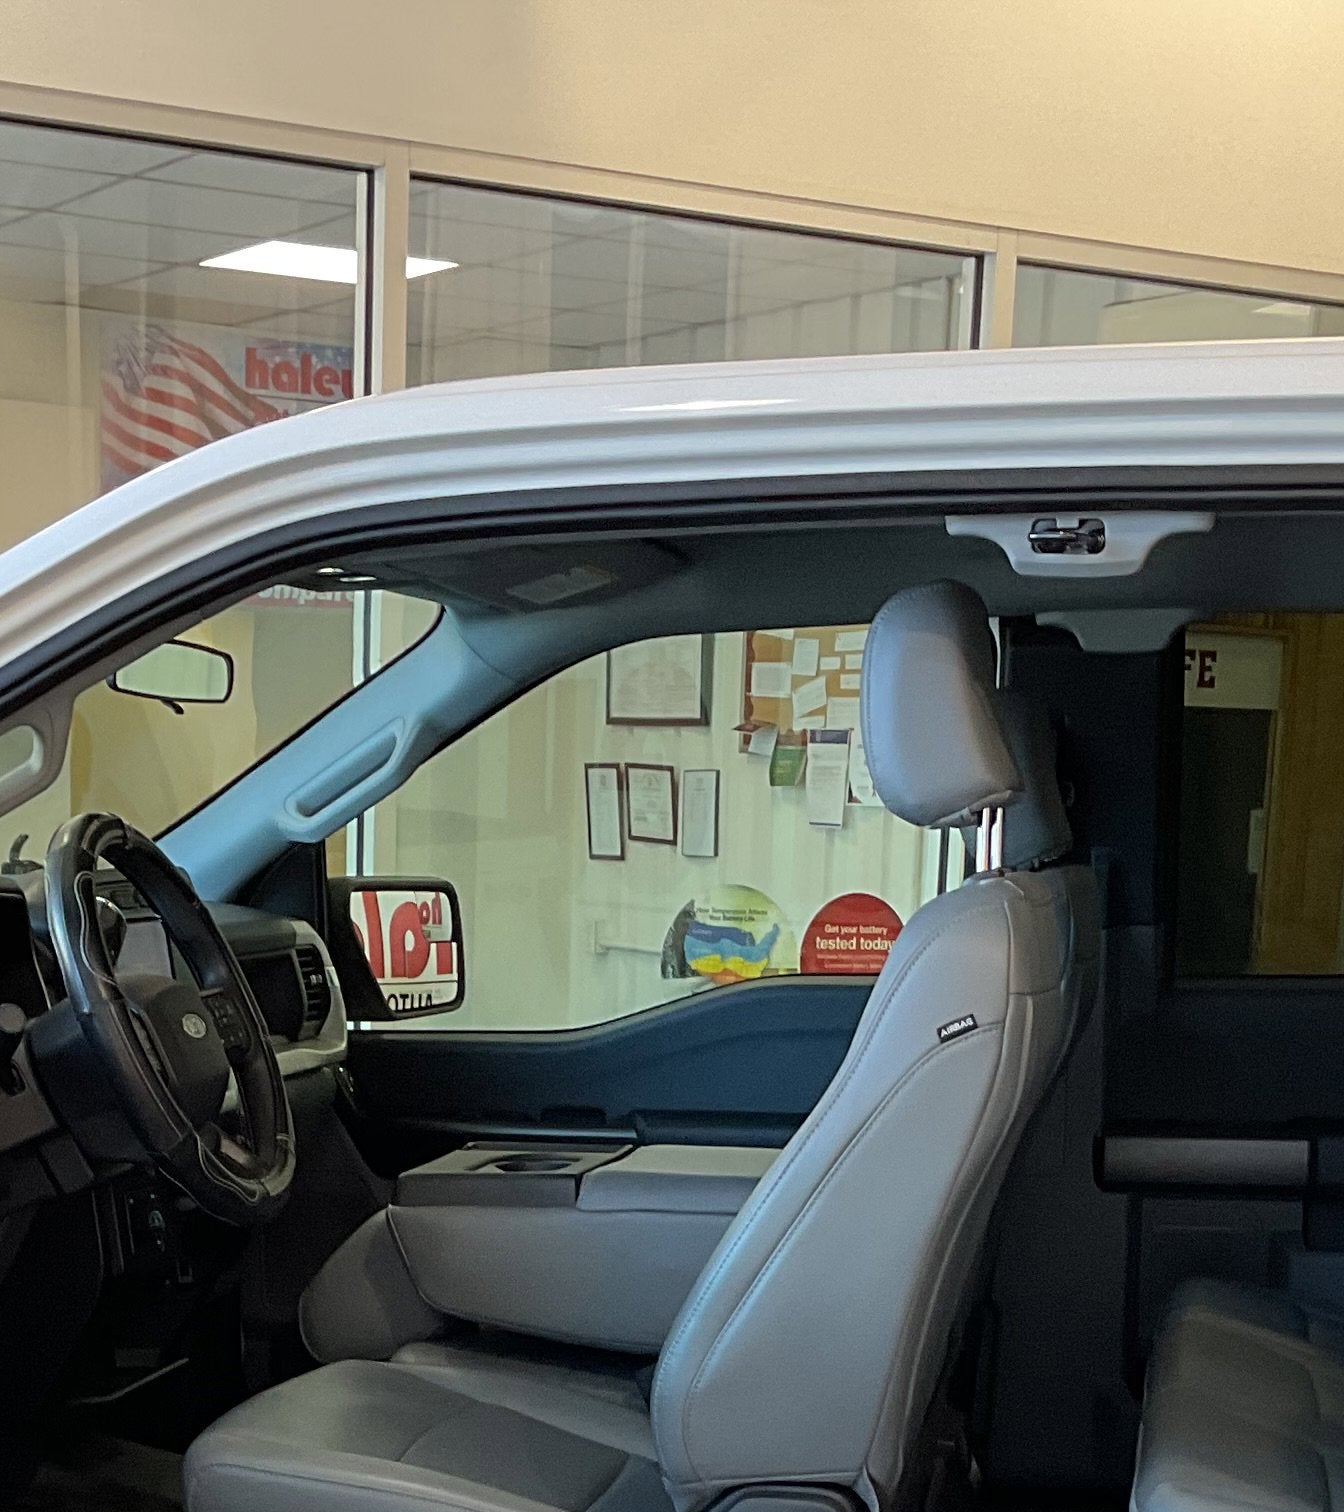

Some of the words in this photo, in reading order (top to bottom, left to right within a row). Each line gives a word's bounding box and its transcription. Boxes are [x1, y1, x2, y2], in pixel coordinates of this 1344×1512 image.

[840, 926, 858, 936] your
[859, 925, 888, 936] battery
[816, 936, 856, 950] tested
[940, 1017, 974, 1038] AIRBAG
